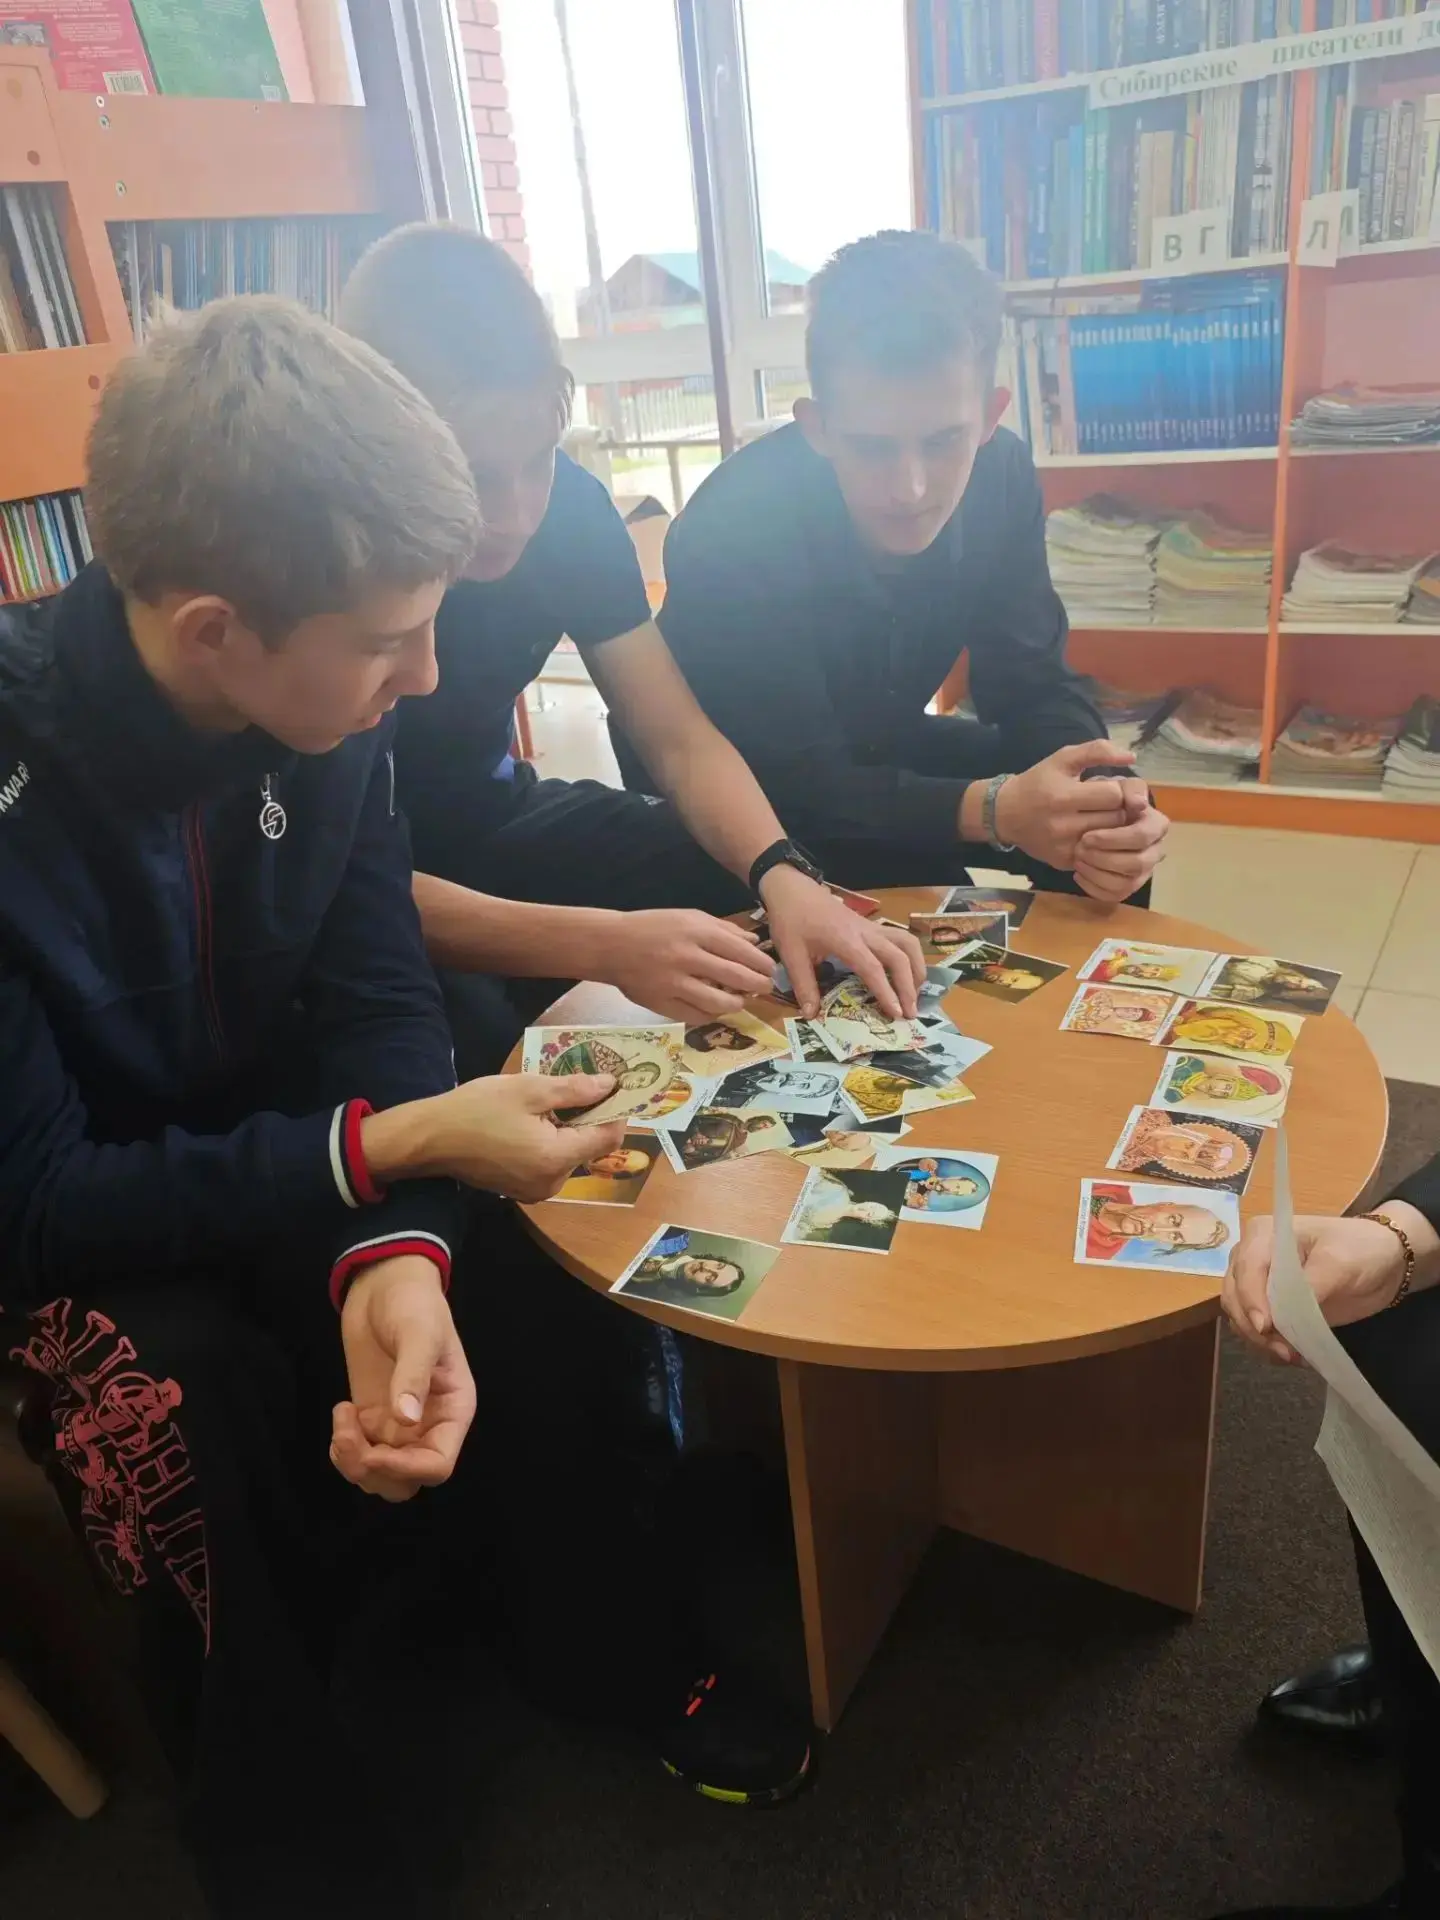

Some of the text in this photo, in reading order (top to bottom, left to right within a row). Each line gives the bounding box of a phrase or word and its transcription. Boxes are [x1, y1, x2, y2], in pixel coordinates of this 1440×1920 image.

[1099, 57, 1238, 100] Сибирские
[1271, 26, 1404, 65] писатели
[1163, 226, 1216, 262] В Г
[1305, 219, 1329, 250] Л
